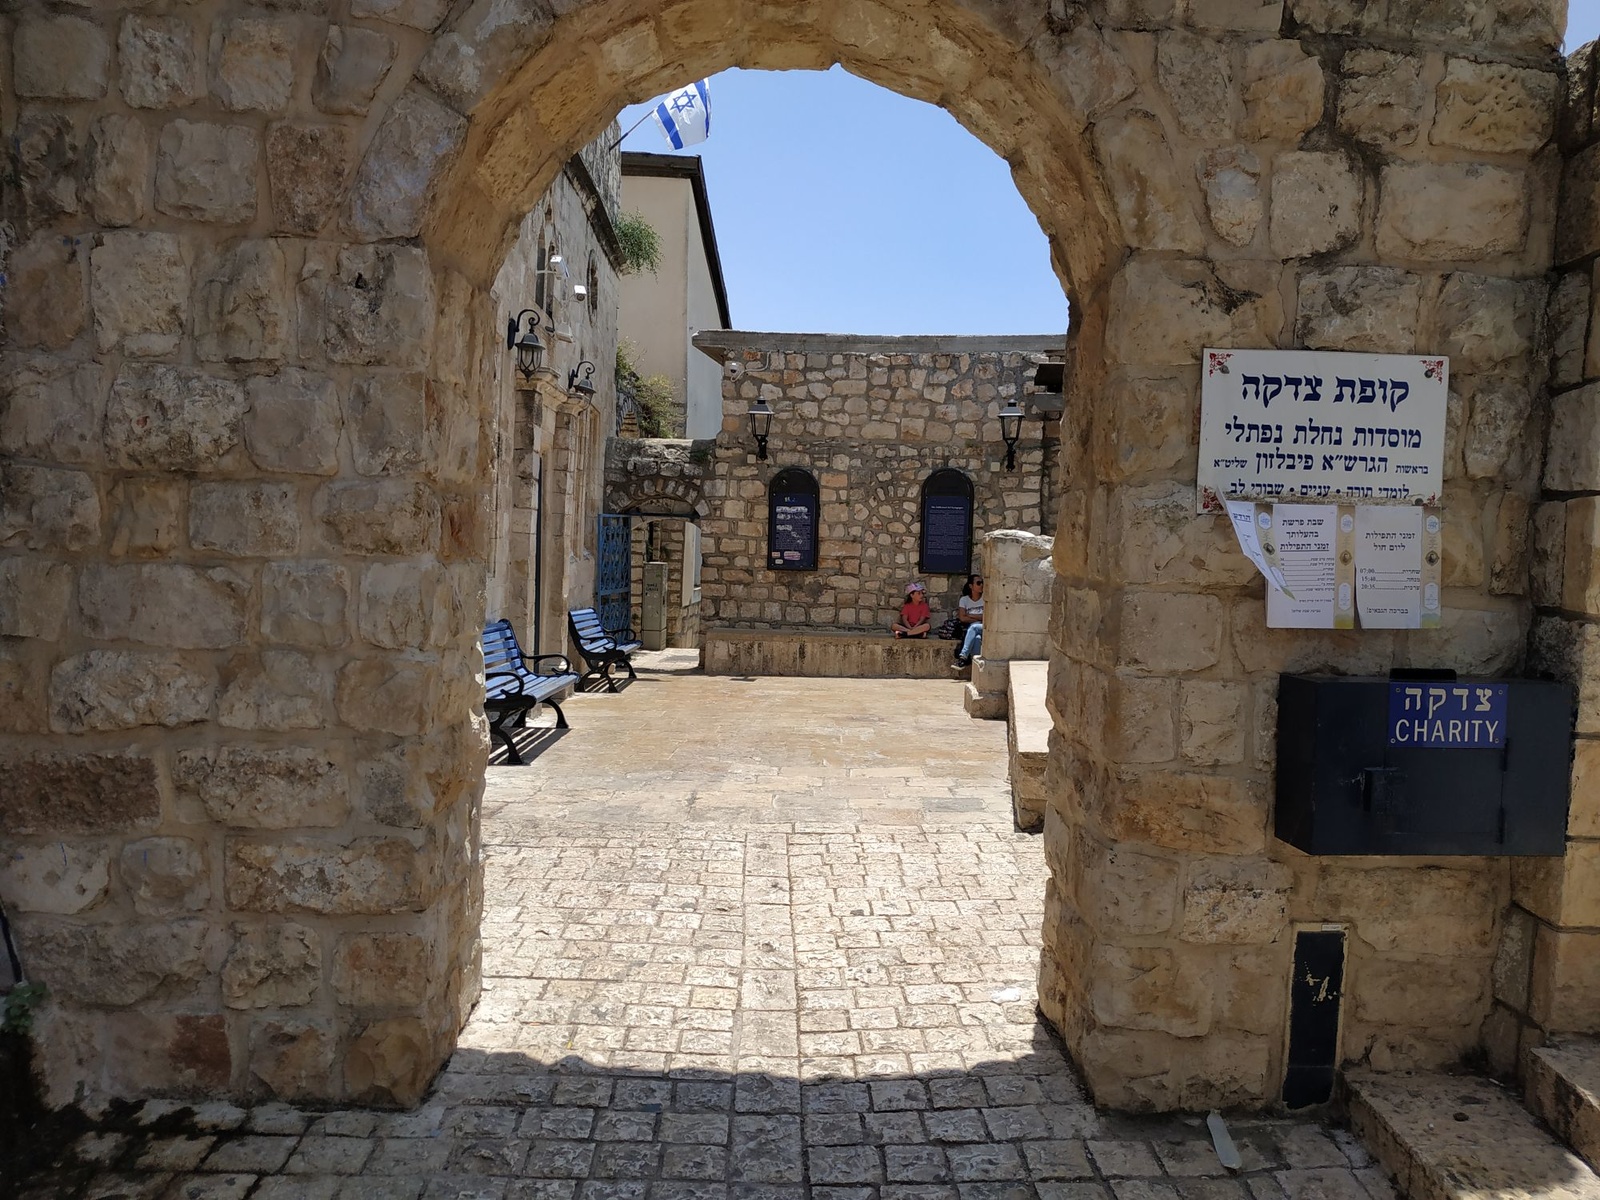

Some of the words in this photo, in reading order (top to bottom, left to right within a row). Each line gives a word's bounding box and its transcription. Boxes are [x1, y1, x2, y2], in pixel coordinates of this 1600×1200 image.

[1241, 373, 1323, 409] צדקה
[1333, 376, 1409, 413] קופת
[1225, 415, 1283, 444] נפתלי
[1293, 418, 1343, 448] נחלת
[1352, 427, 1422, 448] מוסדות
[1256, 447, 1314, 474] פיבלזון
[1395, 463, 1429, 475] בראשות
[1230, 479, 1245, 494] לב
[1251, 483, 1285, 496] שבורי
[1300, 484, 1331, 496] עניים
[1346, 485, 1373, 499] תורה
[1378, 484, 1410, 500] לומדי
[1282, 518, 1305, 526] פרשת
[1307, 518, 1324, 526] שבת
[1365, 531, 1397, 539] התפילות
[1400, 531, 1415, 539] זמני
[1280, 542, 1312, 550] התפילות
[1314, 542, 1329, 550] זמני
[1373, 543, 1388, 551] חול
[1390, 543, 1406, 551] ליום
[1404, 687, 1493, 719] צדקה
[1395, 719, 1499, 742] CHARITY
